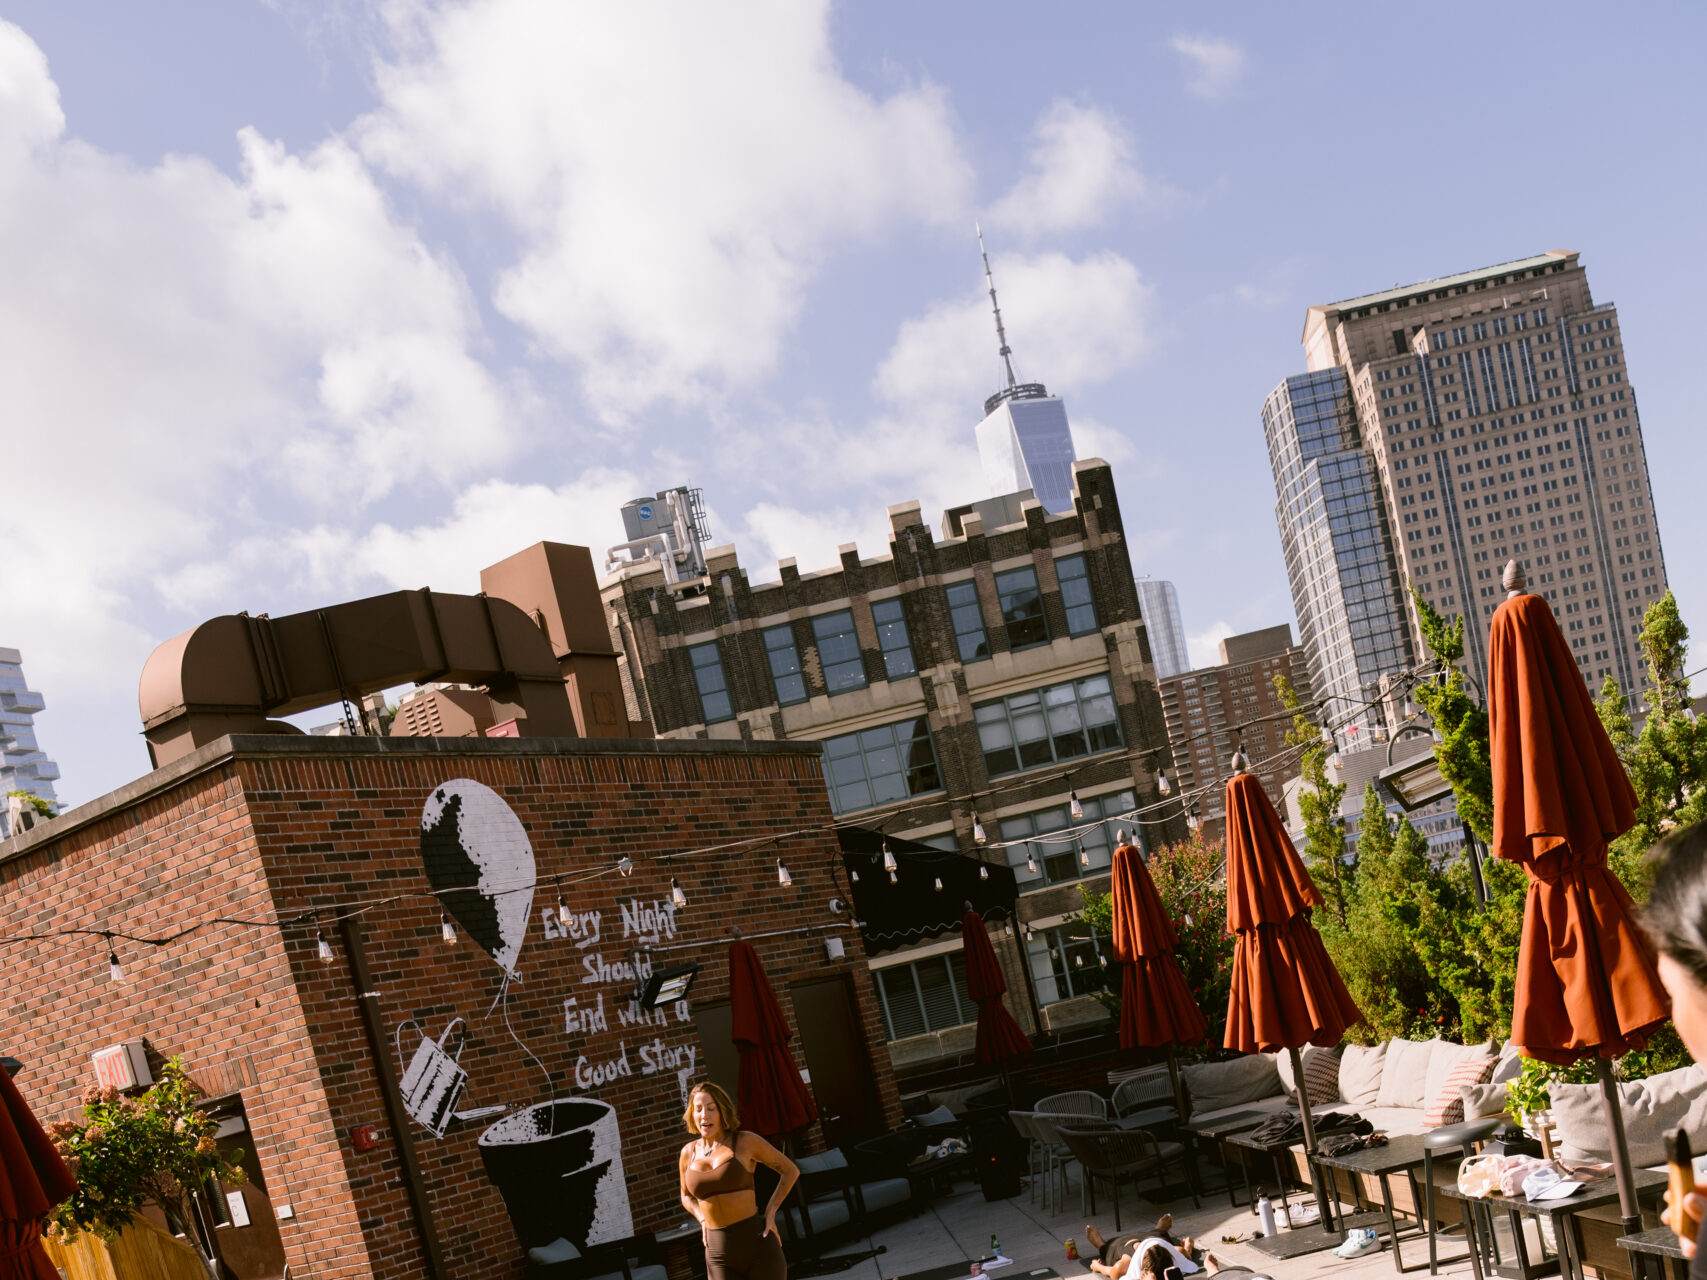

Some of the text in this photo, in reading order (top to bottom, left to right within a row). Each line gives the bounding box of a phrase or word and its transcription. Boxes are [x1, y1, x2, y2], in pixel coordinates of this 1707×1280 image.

[541, 895, 678, 949] Every Night
[582, 945, 653, 984] Should
[563, 992, 608, 1035] End
[675, 999, 691, 1022] a
[96, 1052, 128, 1087] EXIT
[575, 1038, 696, 1089] Good Story
